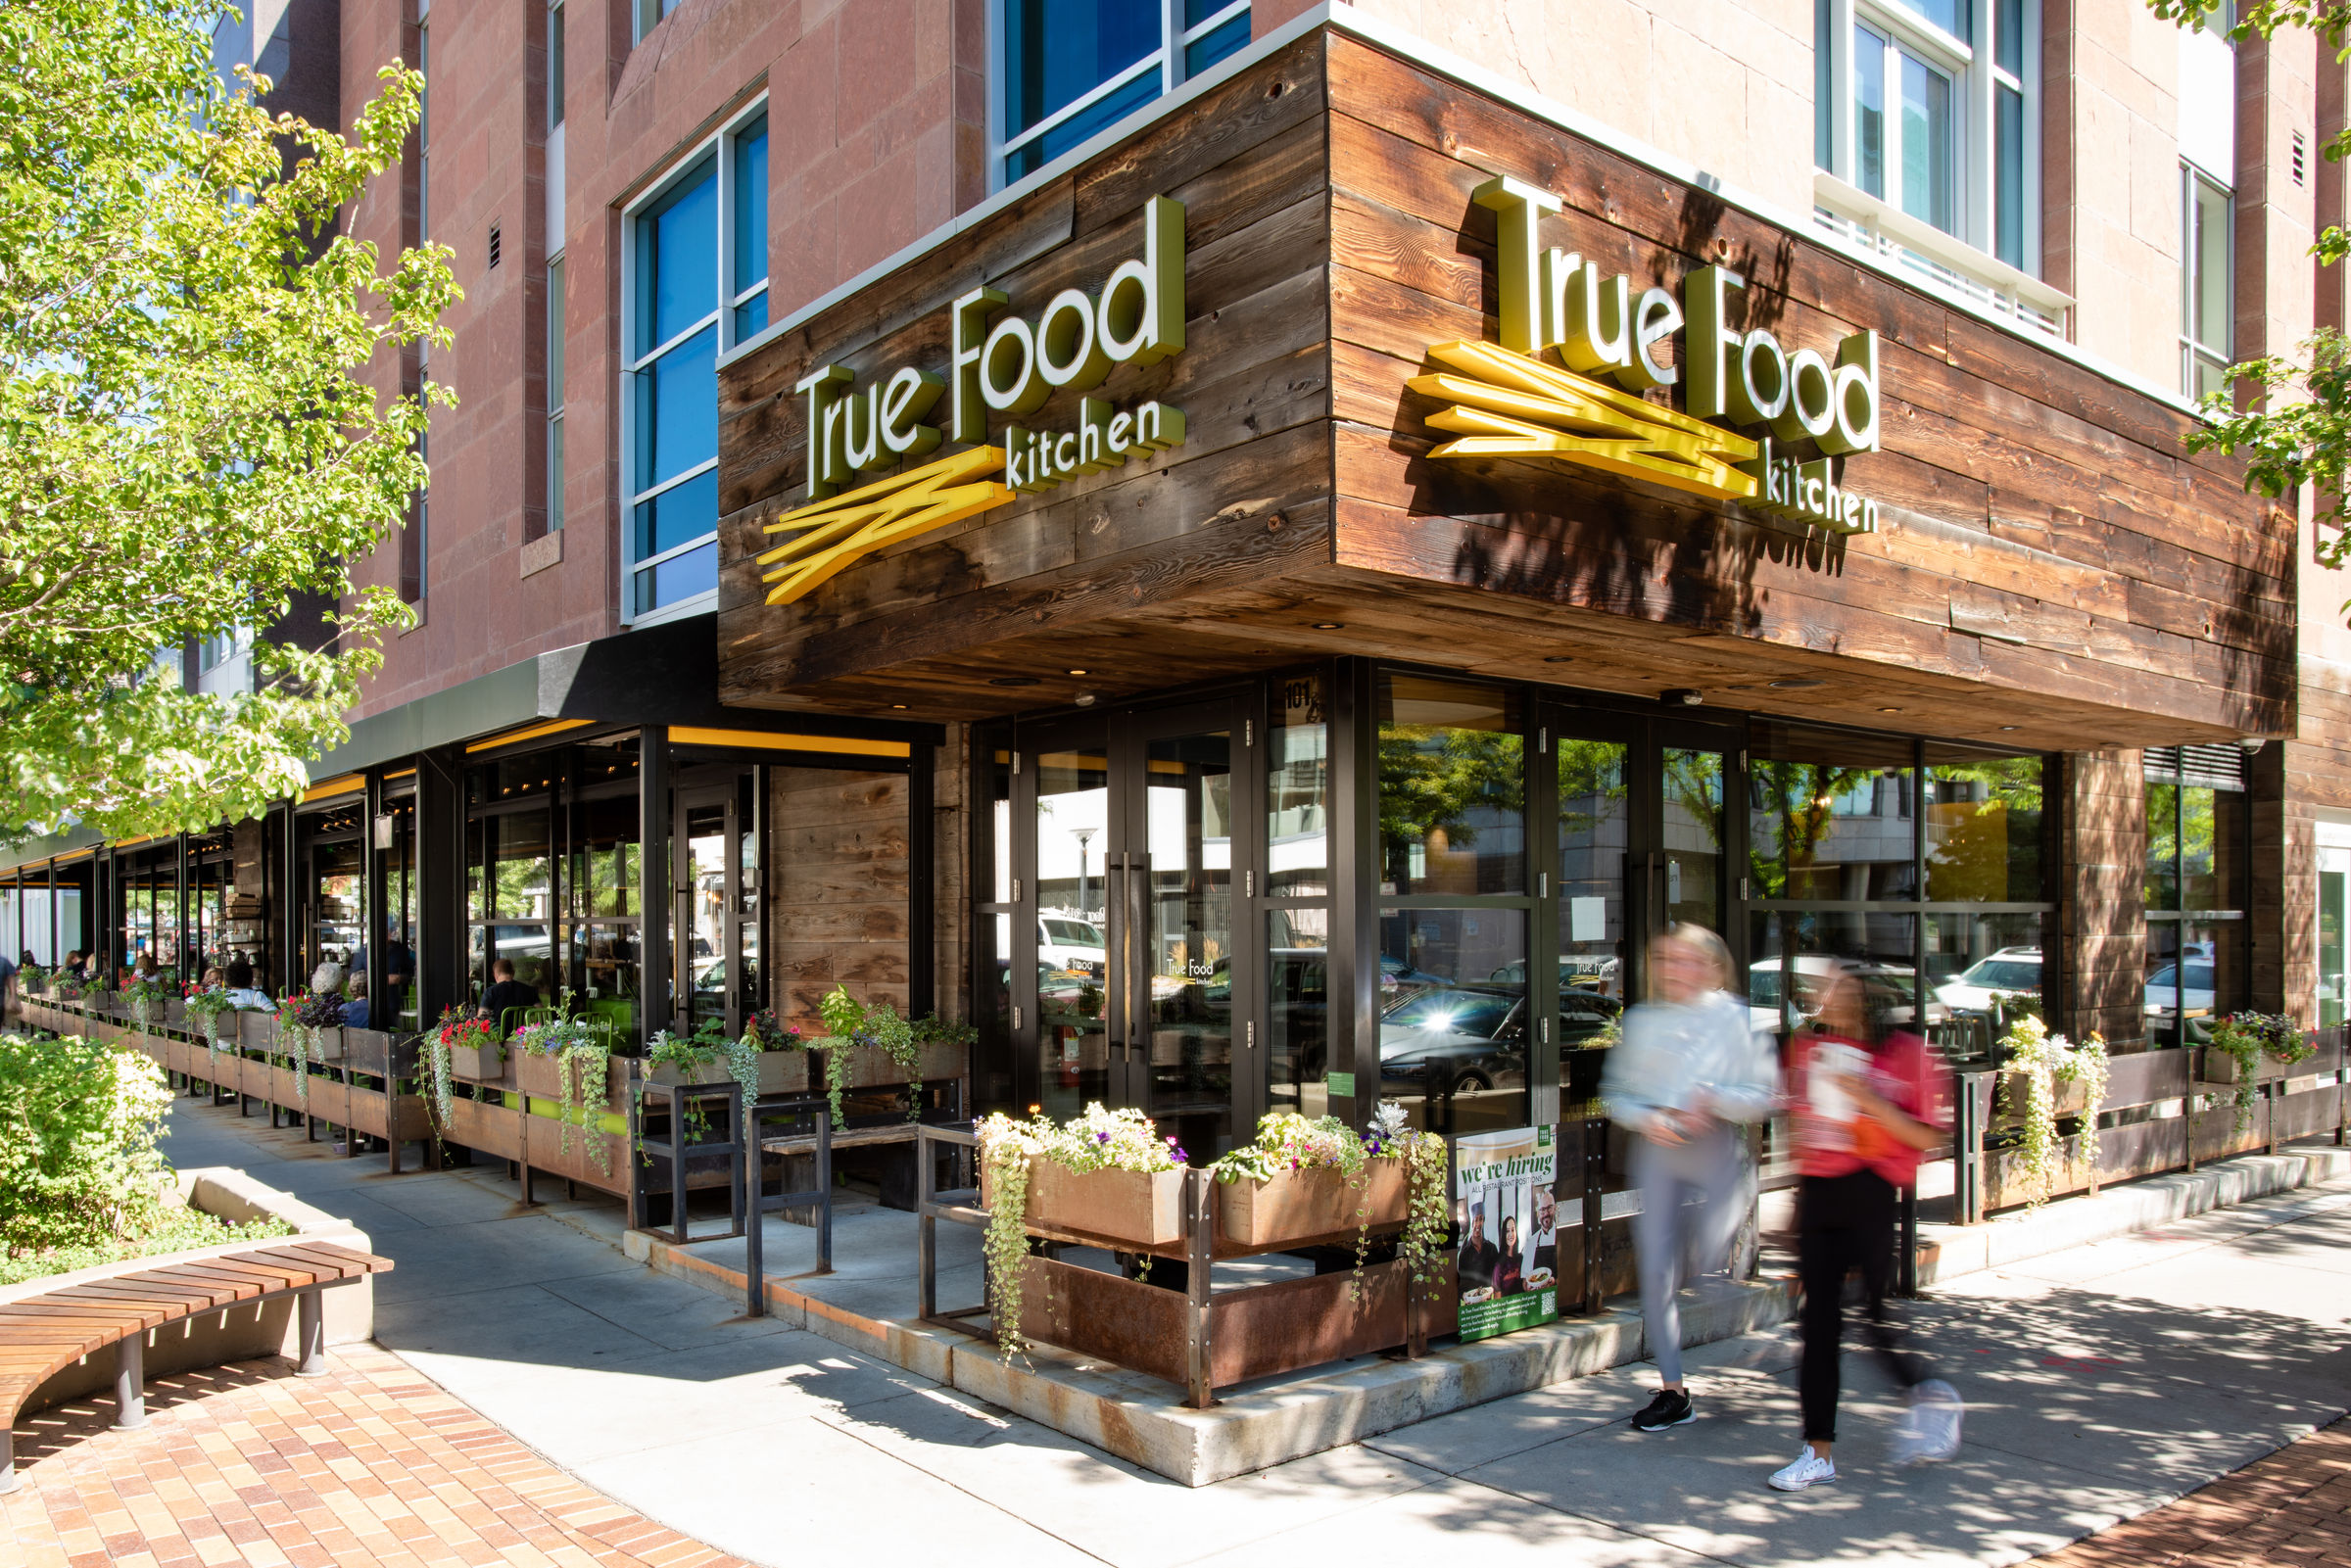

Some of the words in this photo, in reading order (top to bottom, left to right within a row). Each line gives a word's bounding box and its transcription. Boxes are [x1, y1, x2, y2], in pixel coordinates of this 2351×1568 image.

[1499, 173, 1684, 391] True
[1704, 263, 1880, 452] Food
[795, 365, 931, 499] True
[952, 194, 1166, 443] Food
[1005, 397, 1162, 492] kitchen
[1763, 437, 1878, 534] kitchen
[1286, 681, 1310, 709] 101
[1167, 959, 1186, 975] True
[1188, 959, 1213, 976] Food
[1461, 1161, 1503, 1184] we're
[1506, 1152, 1554, 1176] hiring
[1471, 1185, 1482, 1194] ALL
[1482, 1178, 1514, 1191] RESTAURANT
[1515, 1174, 1543, 1186] POSITIONS
